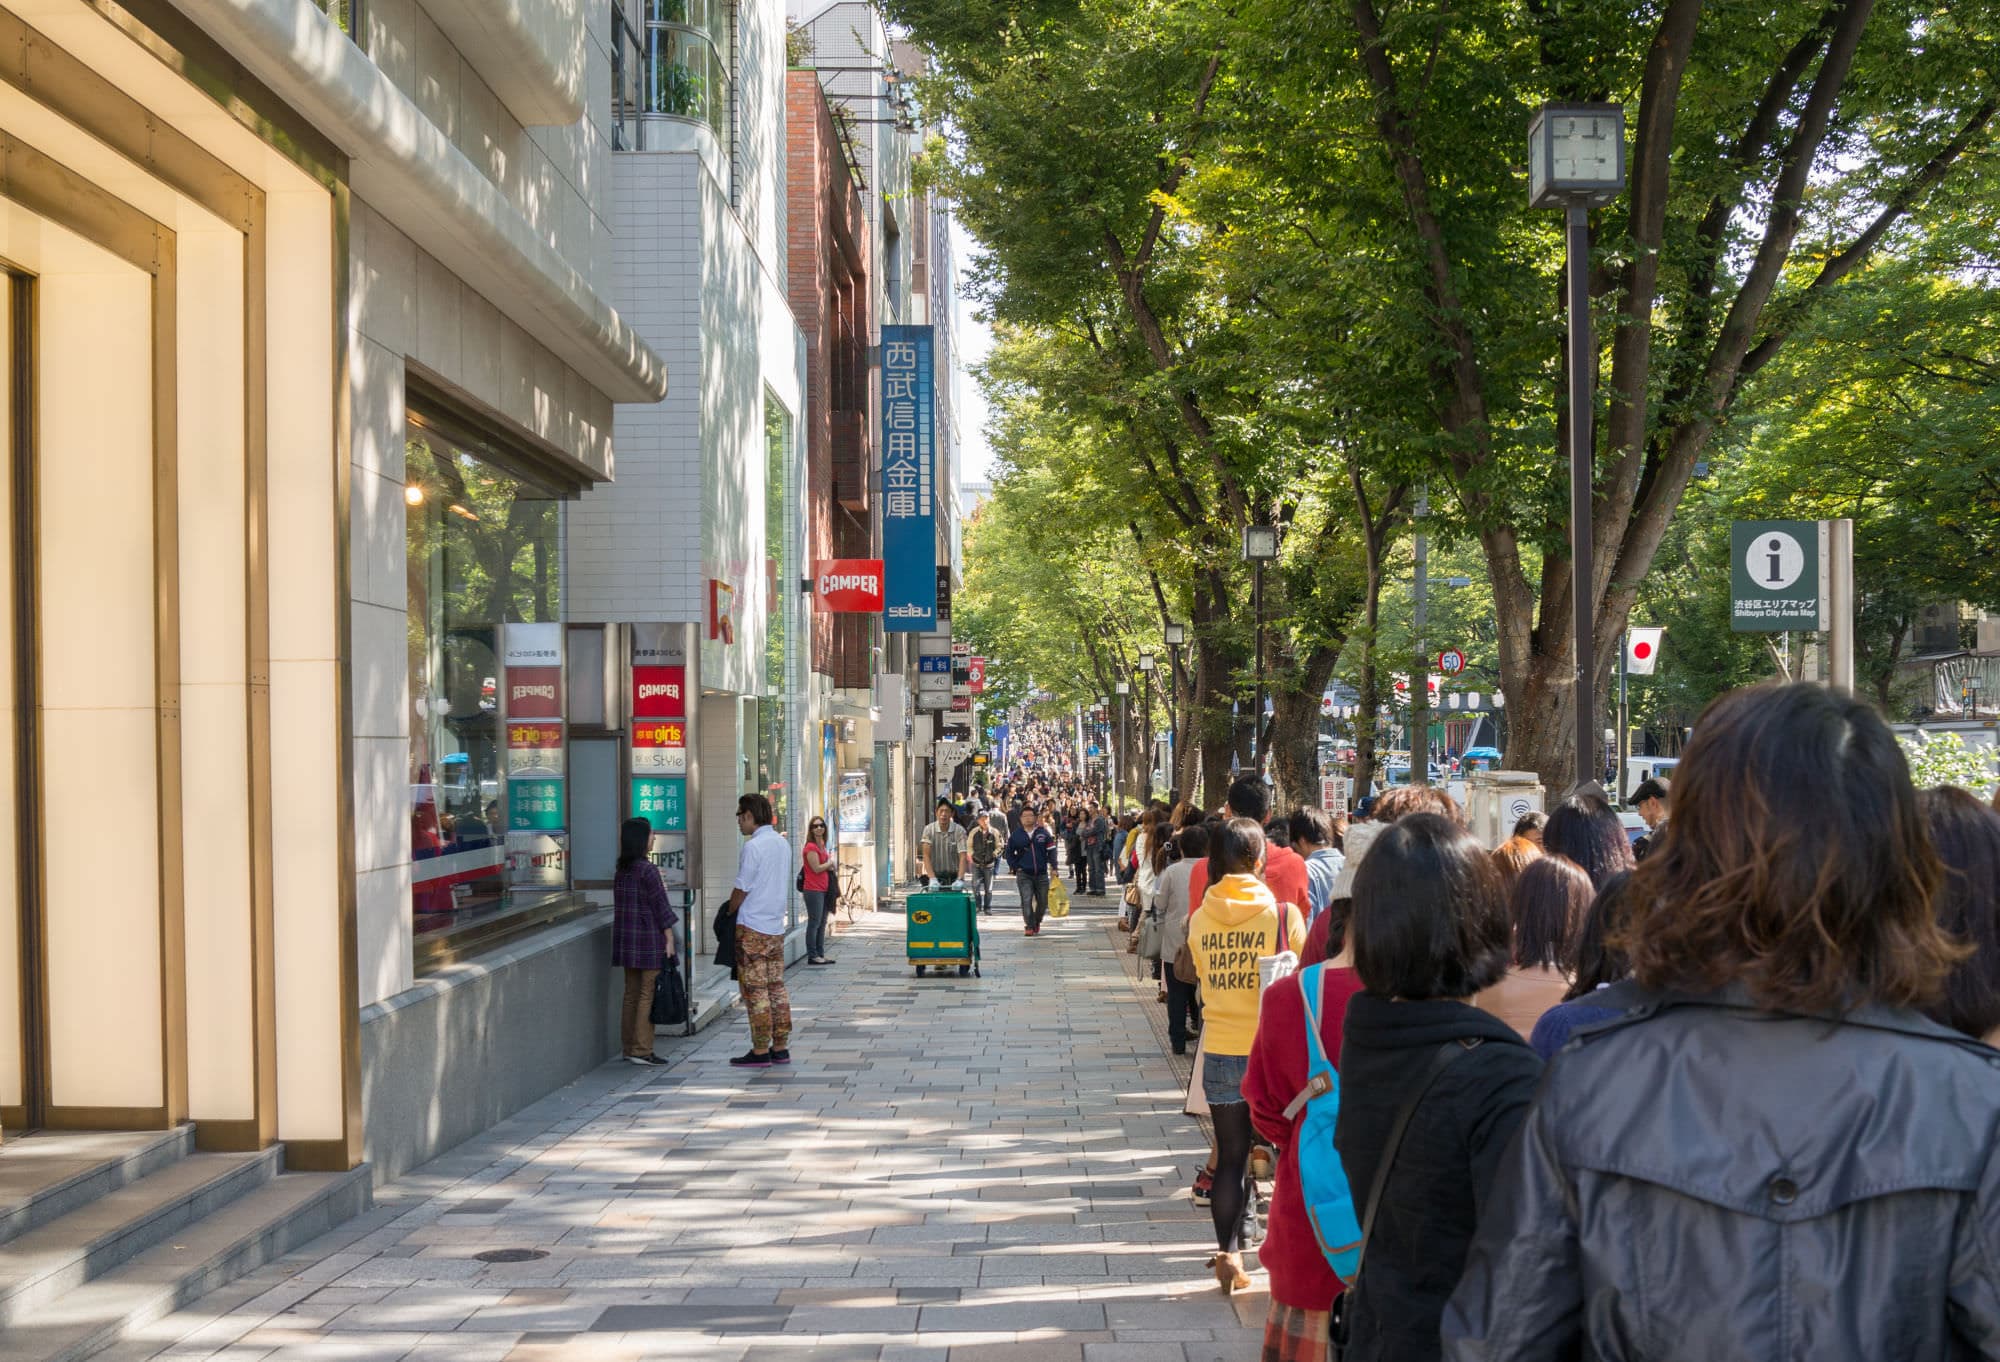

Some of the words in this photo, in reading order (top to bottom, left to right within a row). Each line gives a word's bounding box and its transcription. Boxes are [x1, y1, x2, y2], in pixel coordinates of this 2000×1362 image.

[885, 341, 918, 519] 西武信用金庫
[819, 573, 879, 598] CAMPER
[1734, 599, 1816, 609] 渋谷区エリアマップ
[1734, 609, 1764, 618] Shibuya
[1765, 609, 1780, 618] City
[1781, 609, 1799, 617] Area
[1800, 609, 1816, 618] Map
[1443, 655, 1459, 669] 50
[638, 684, 680, 700] CAMPER
[654, 725, 681, 744] girls
[639, 784, 678, 797] 表参道
[639, 798, 678, 812] 皮膚科
[665, 816, 680, 826] 4F
[1201, 931, 1265, 952] HALEIWA
[1209, 951, 1258, 971] HAPPY
